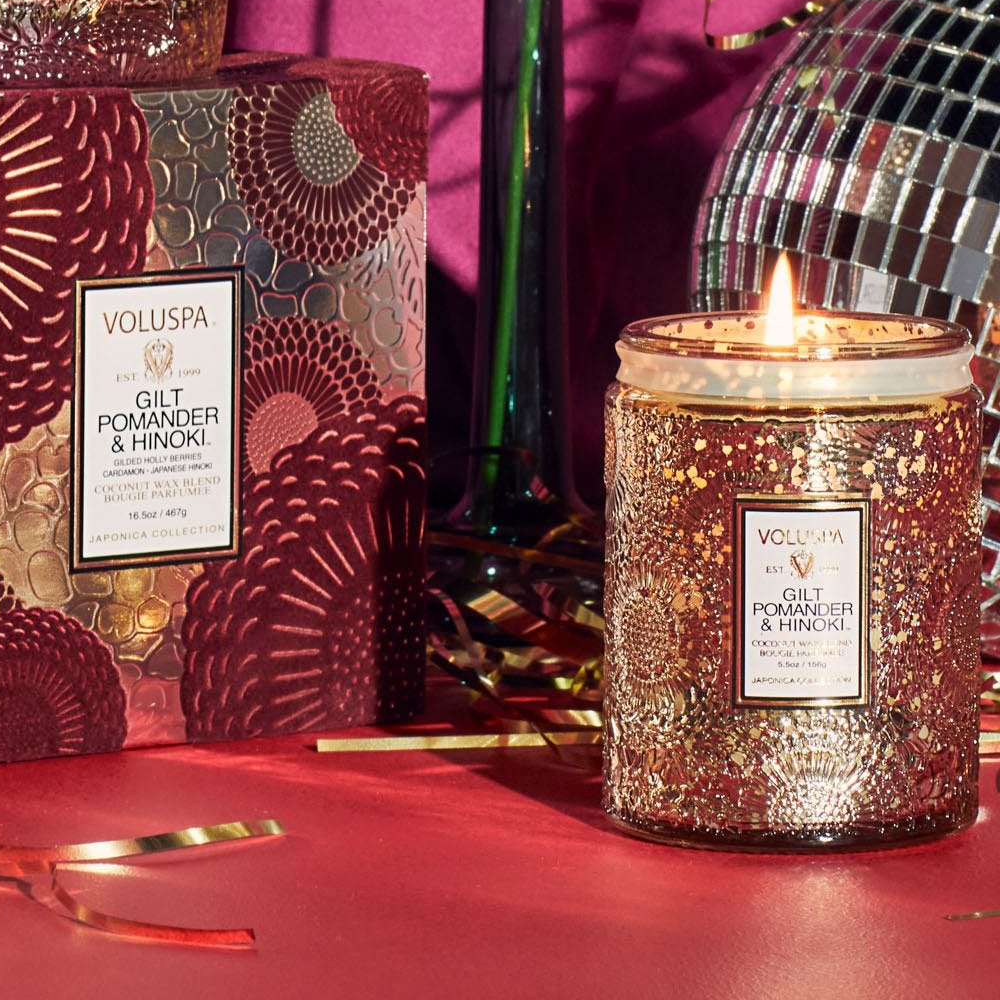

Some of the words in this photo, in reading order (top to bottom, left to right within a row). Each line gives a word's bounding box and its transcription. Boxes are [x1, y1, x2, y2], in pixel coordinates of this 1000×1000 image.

[103, 305, 208, 334] VOLUSPA
[179, 368, 201, 379] 1999
[136, 388, 184, 410] GILT
[98, 407, 219, 433] POMANDER
[111, 435, 125, 453] &
[132, 429, 206, 451] HINOKI
[113, 457, 142, 467] GILDED
[144, 455, 168, 464] HOLLY
[170, 453, 202, 462] BERRIES
[102, 468, 145, 478] CARDAMON
[151, 465, 187, 475] JAPANESE
[188, 462, 213, 471] HINOKI
[94, 481, 150, 494] COCONUT
[153, 480, 180, 490] WAX
[183, 476, 221, 487] BLEND
[104, 492, 149, 503] BOUGIE
[128, 511, 157, 520] 16.5oz
[165, 508, 187, 517] 467g
[89, 531, 147, 543] JAPONICA
[151, 525, 225, 538] COLLECTION
[783, 588, 824, 601] GILT
[753, 602, 853, 616] POMANDER
[761, 618, 772, 631] &
[779, 618, 844, 631] HINOKI
